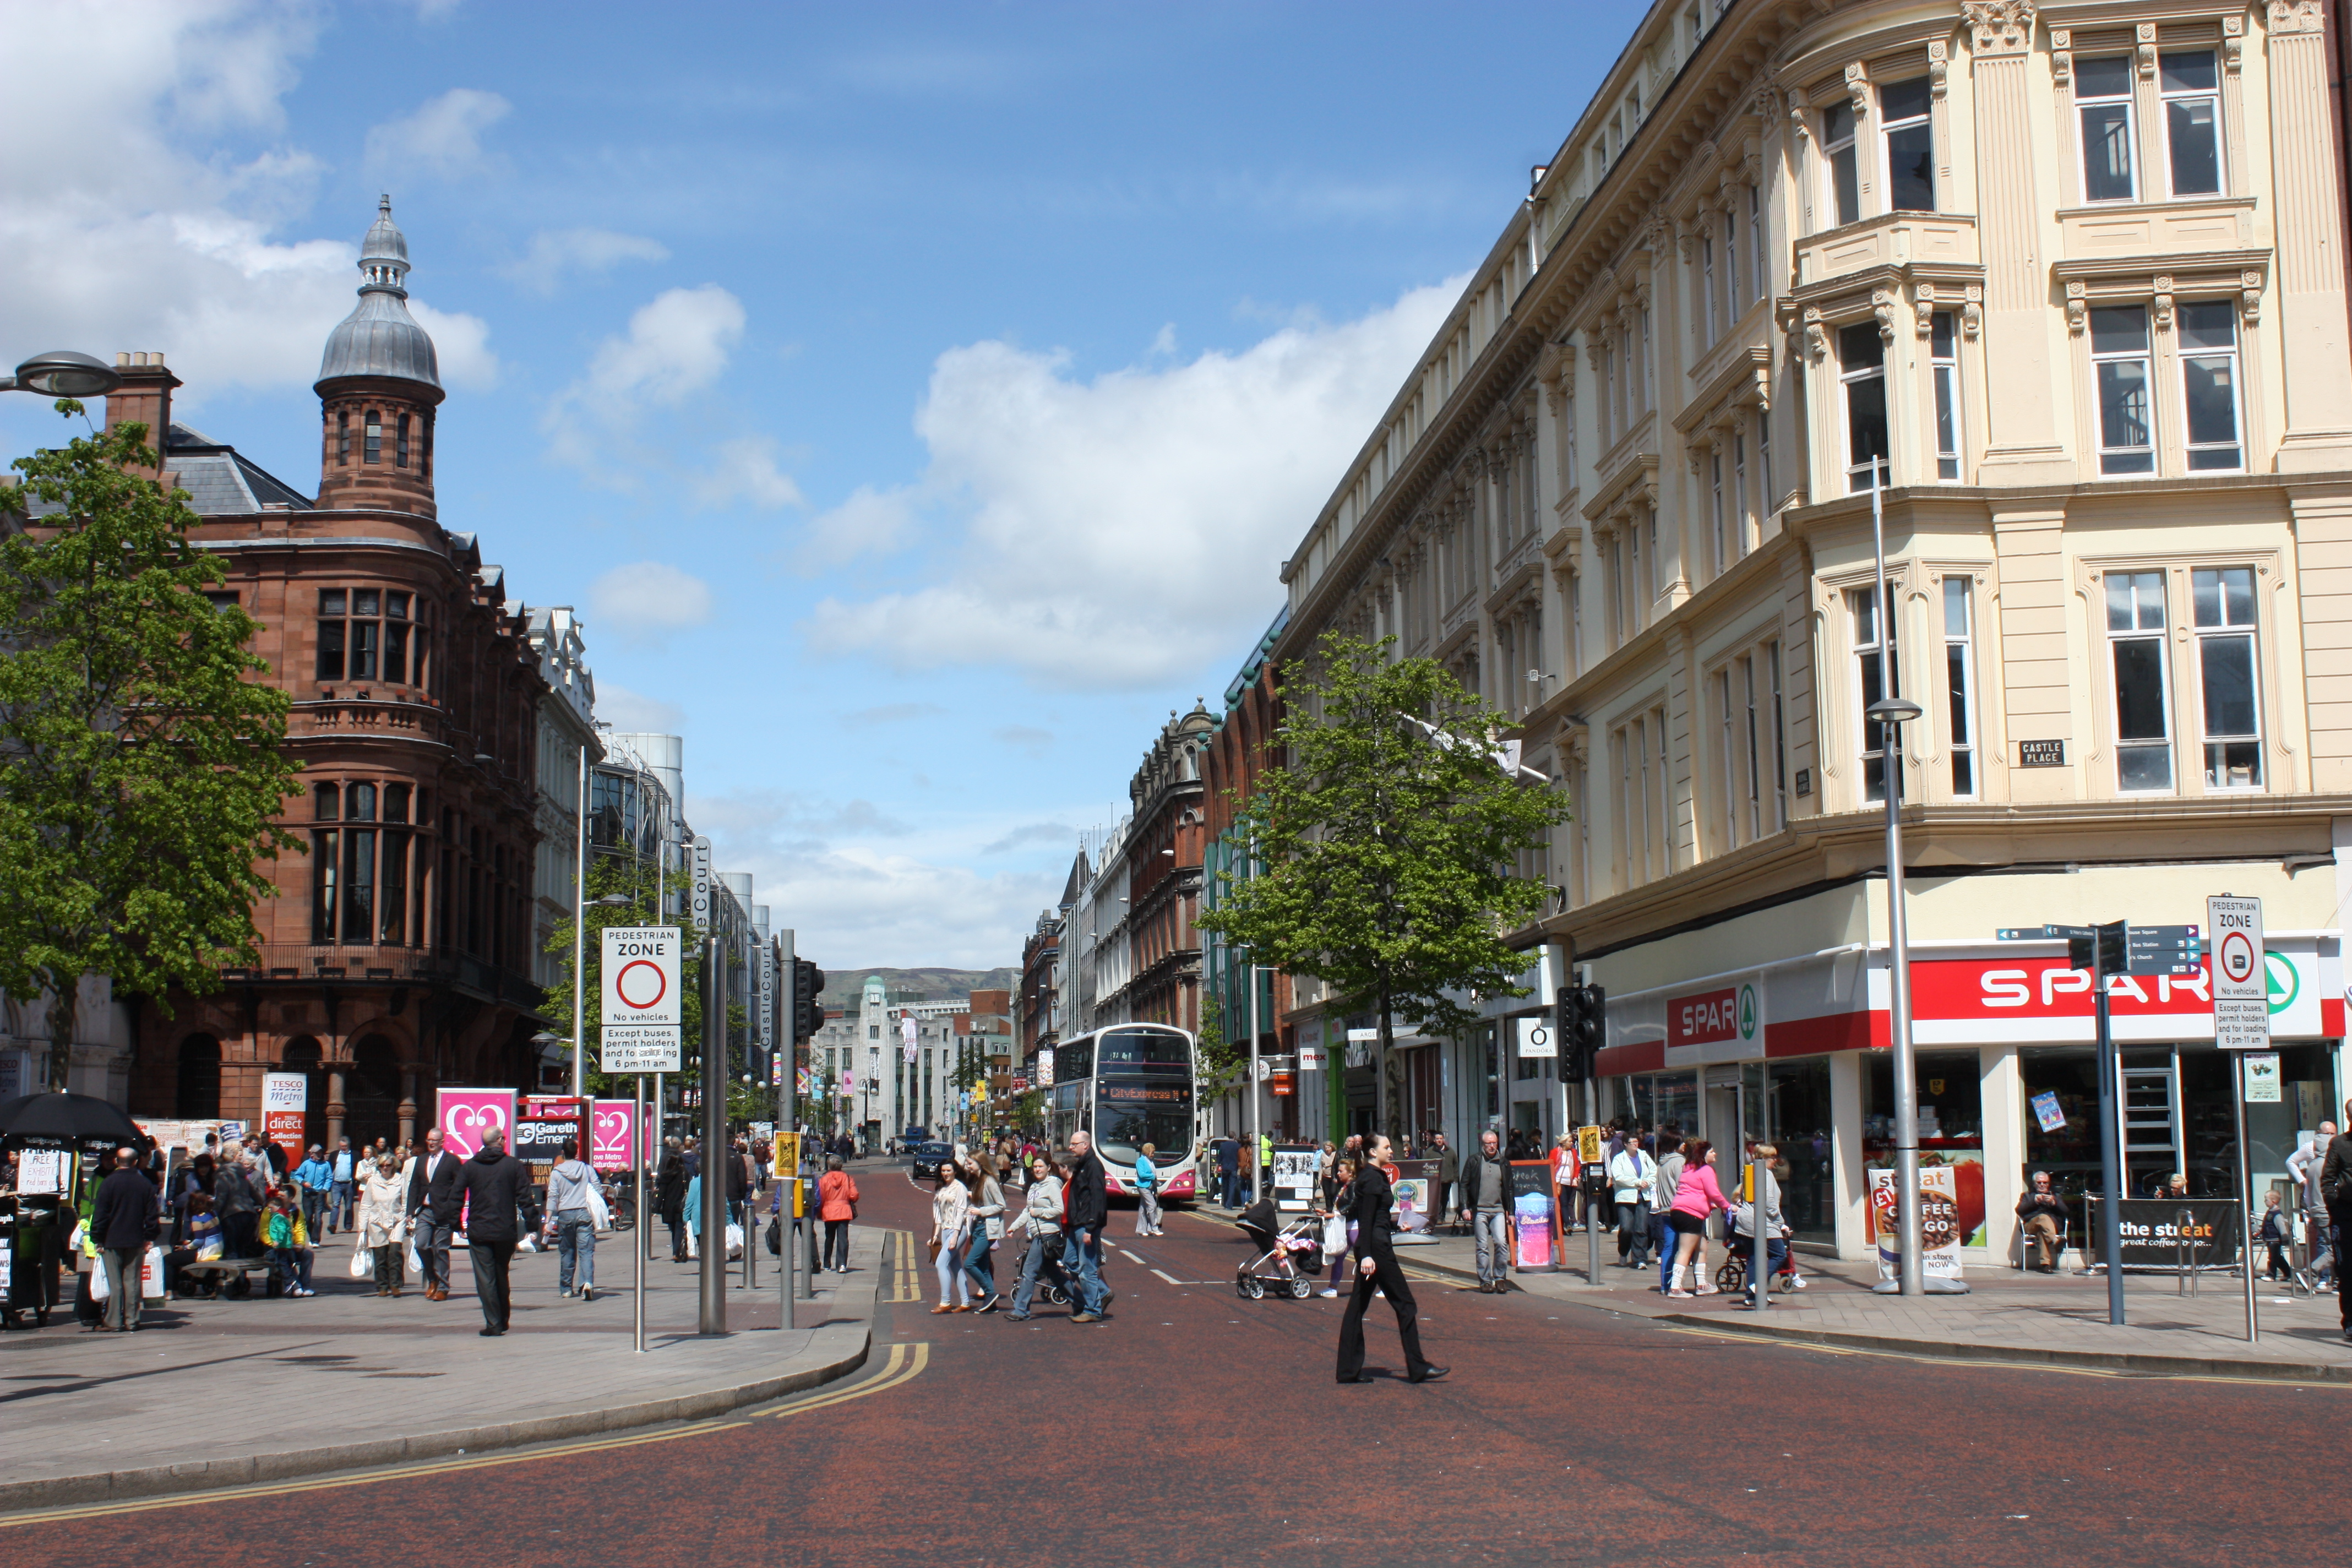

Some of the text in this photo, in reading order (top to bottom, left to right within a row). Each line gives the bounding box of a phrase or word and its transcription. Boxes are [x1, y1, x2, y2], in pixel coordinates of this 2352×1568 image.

[2023, 743, 2060, 753] CASTLE
[2027, 753, 2057, 763] PLACE
[2213, 901, 2256, 911] PEDESTRIAN
[2220, 914, 2251, 927] ZONE
[618, 944, 665, 956] ZONE
[1980, 968, 2210, 1007] SPAR
[761, 946, 770, 1046] CastleCourt
[2219, 1004, 2241, 1013] Except
[1683, 1007, 1735, 1036] SPAR
[2218, 1014, 2265, 1023] permit holders
[608, 1030, 641, 1038] Except
[2244, 1025, 2267, 1033] loading
[606, 1039, 638, 1048] permit
[270, 1092, 303, 1101] Metro
[269, 1117, 302, 1129] direct
[536, 1123, 578, 1134] Gareth
[24, 1137, 62, 1145] Telegraph
[84, 1140, 117, 1150] Telegraph
[32, 1155, 51, 1164] FREE
[1875, 1190, 1892, 1207] £1
[1924, 1221, 1948, 1232] GO
[2119, 1222, 2149, 1235] the
[2120, 1238, 2148, 1248] great
[2148, 1238, 2177, 1248] coffee
